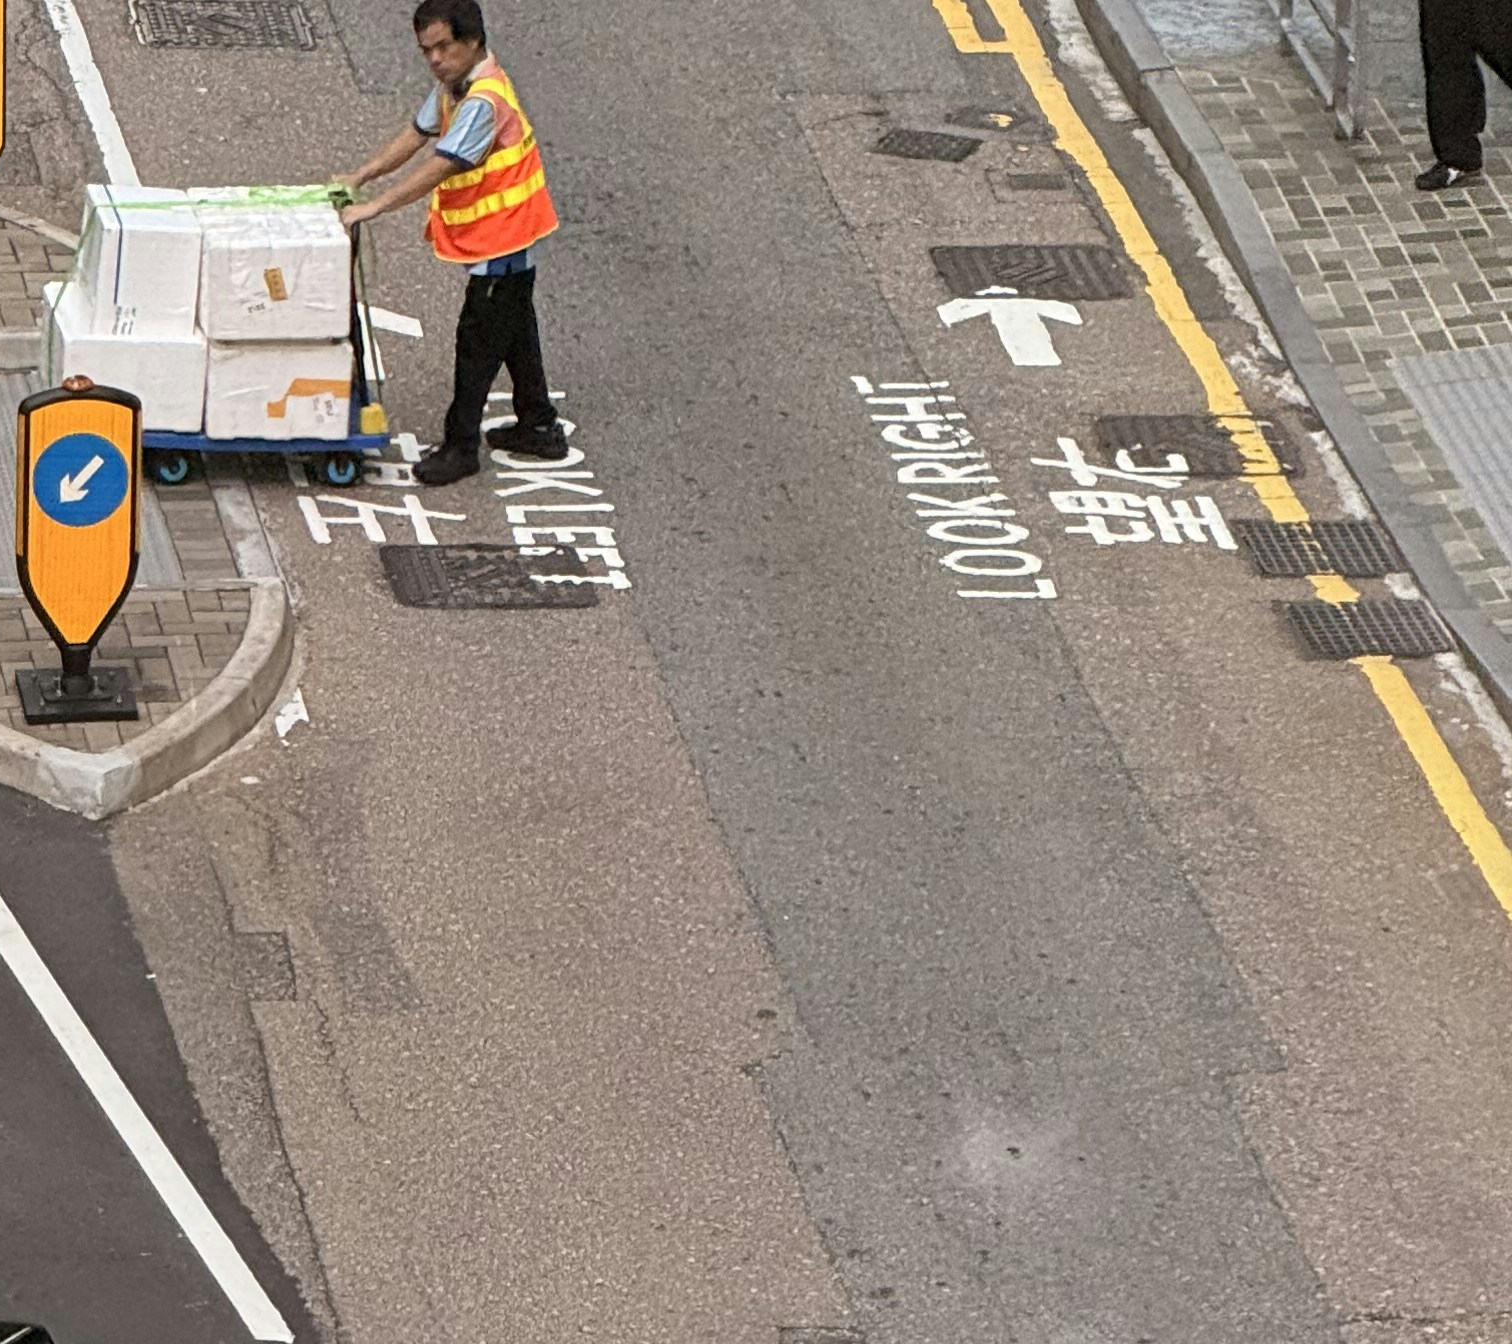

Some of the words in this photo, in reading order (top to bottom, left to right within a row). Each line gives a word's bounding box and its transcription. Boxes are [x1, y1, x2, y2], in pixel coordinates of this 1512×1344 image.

[849, 375, 1000, 484] RIGHT
[505, 502, 633, 590] LEFT
[906, 492, 1058, 600] LOOK
